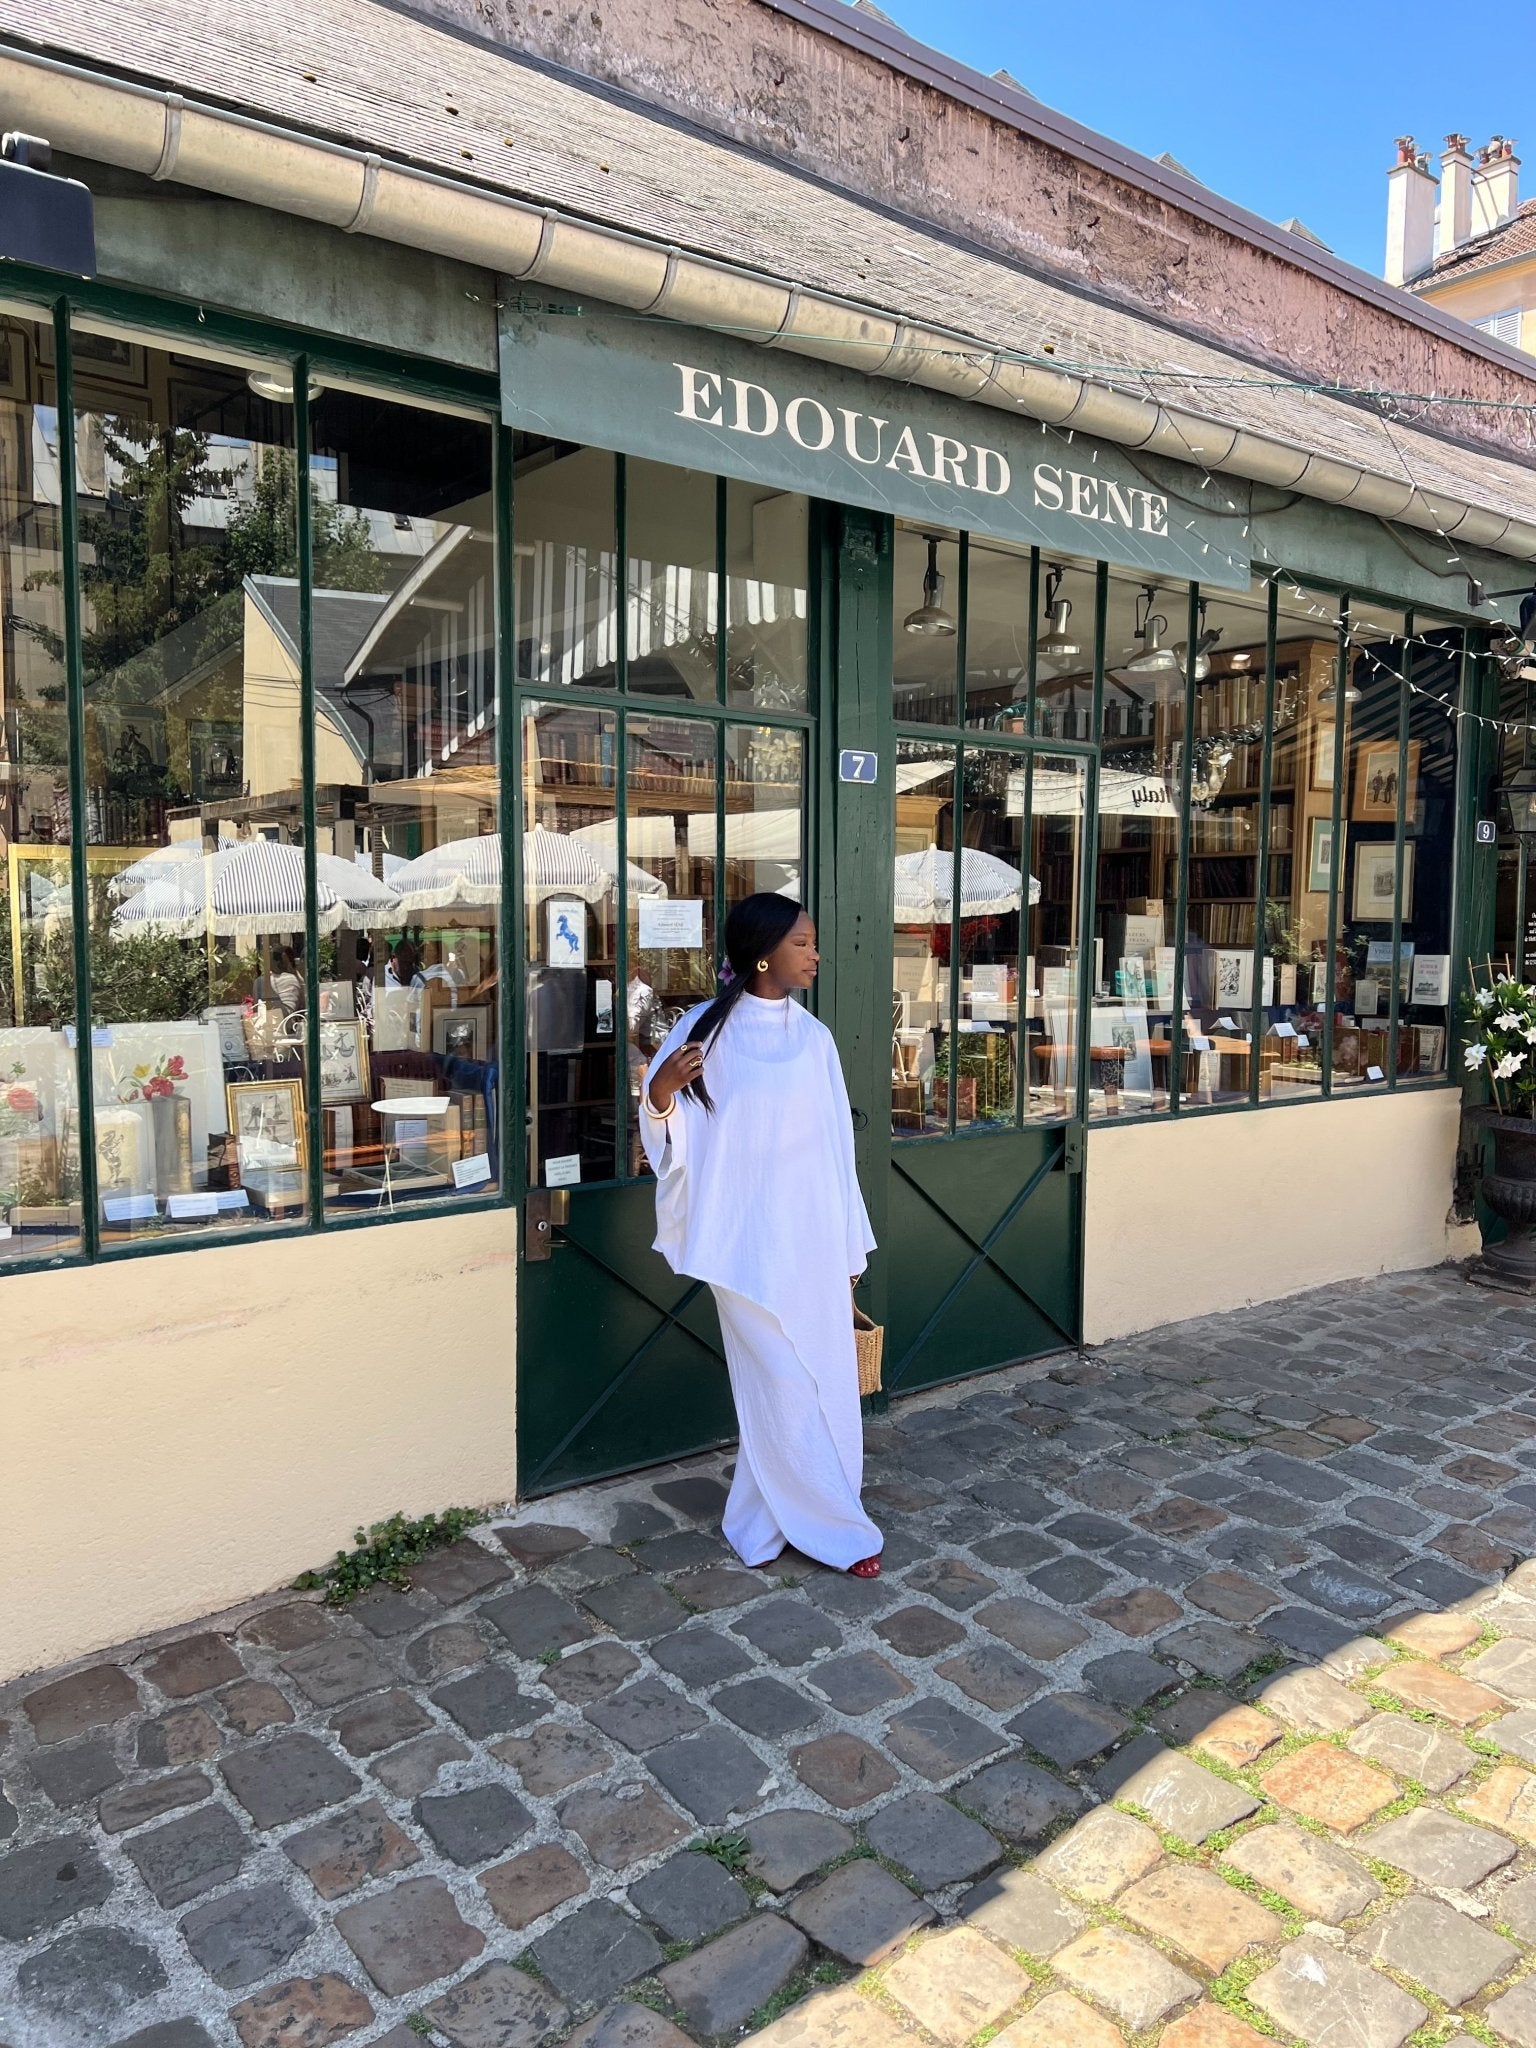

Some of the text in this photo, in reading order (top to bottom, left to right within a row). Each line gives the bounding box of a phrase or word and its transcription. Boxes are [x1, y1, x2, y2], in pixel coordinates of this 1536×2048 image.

[672, 363, 1168, 537] EDOUARD SENE
[852, 755, 865, 778] 7
[1483, 824, 1490, 839] 9
